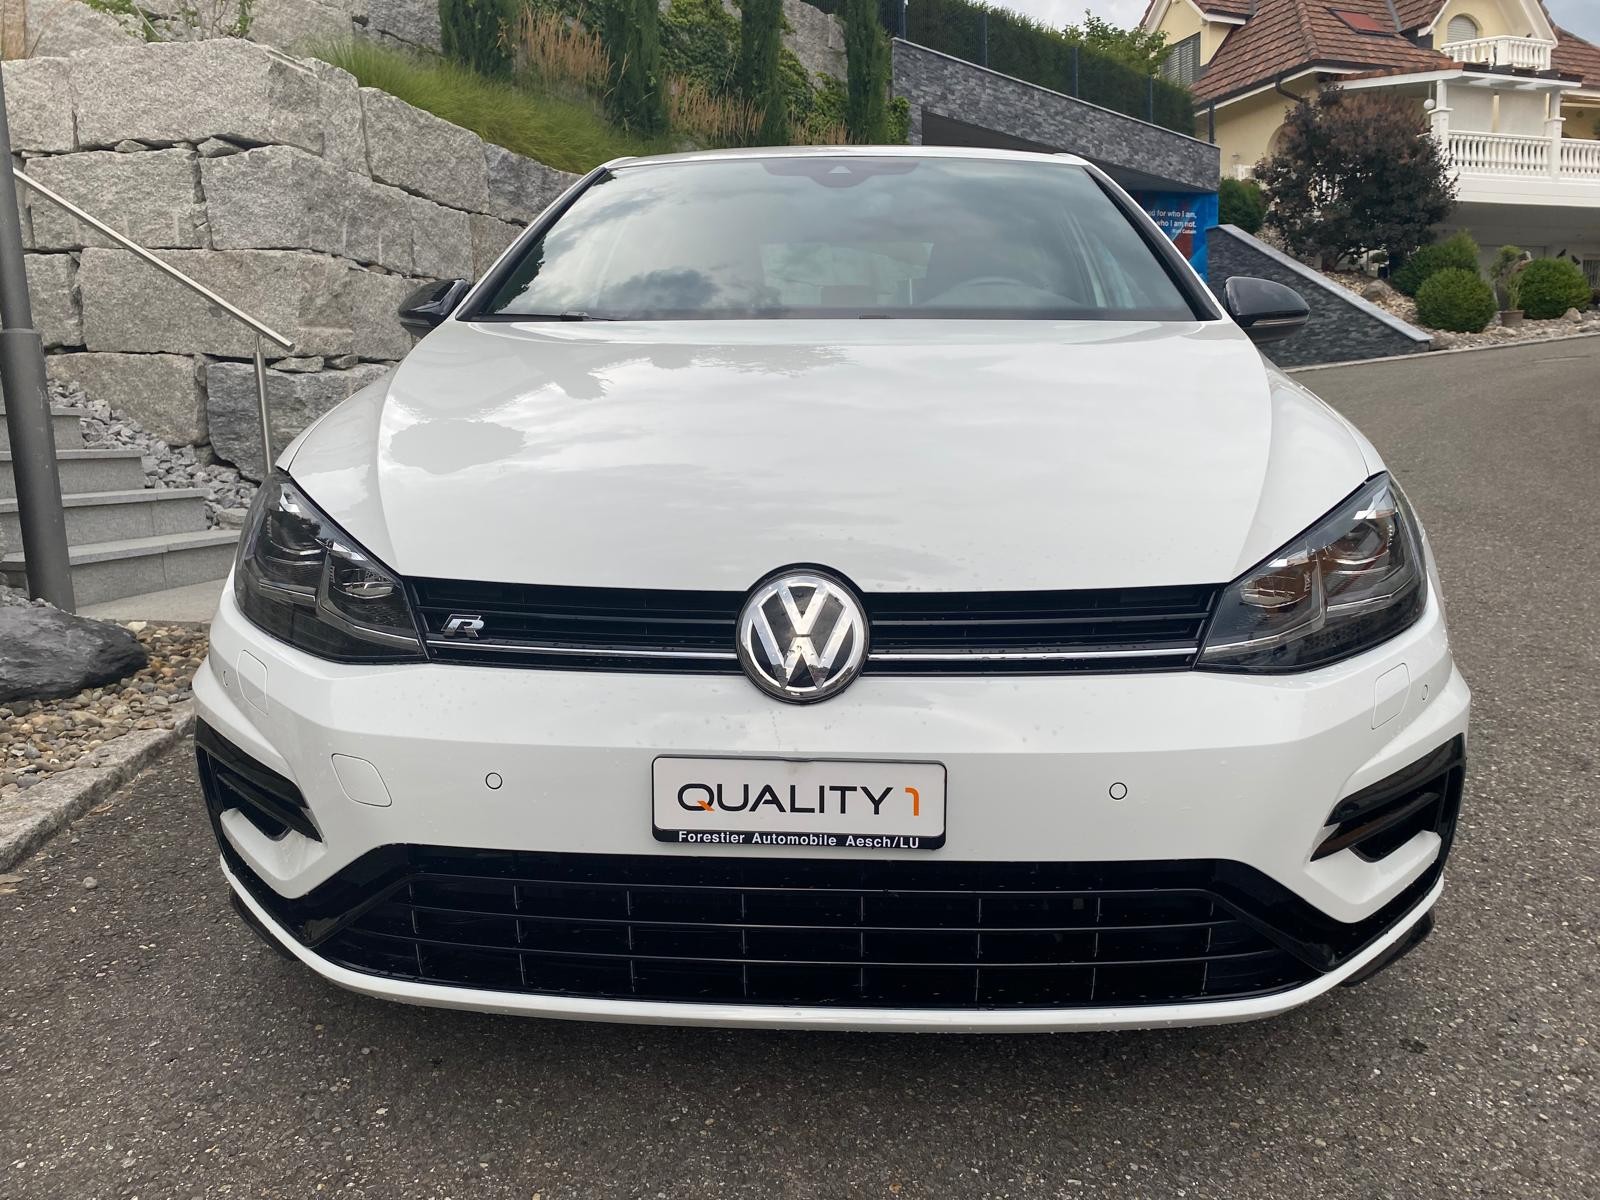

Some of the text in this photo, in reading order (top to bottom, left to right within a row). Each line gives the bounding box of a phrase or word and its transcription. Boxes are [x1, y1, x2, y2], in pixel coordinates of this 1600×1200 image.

[1167, 210, 1181, 218] who
[441, 614, 485, 638] R
[677, 783, 920, 817] QUALITY 1
[678, 831, 920, 849] Forestier Automobile Aesch/LU
